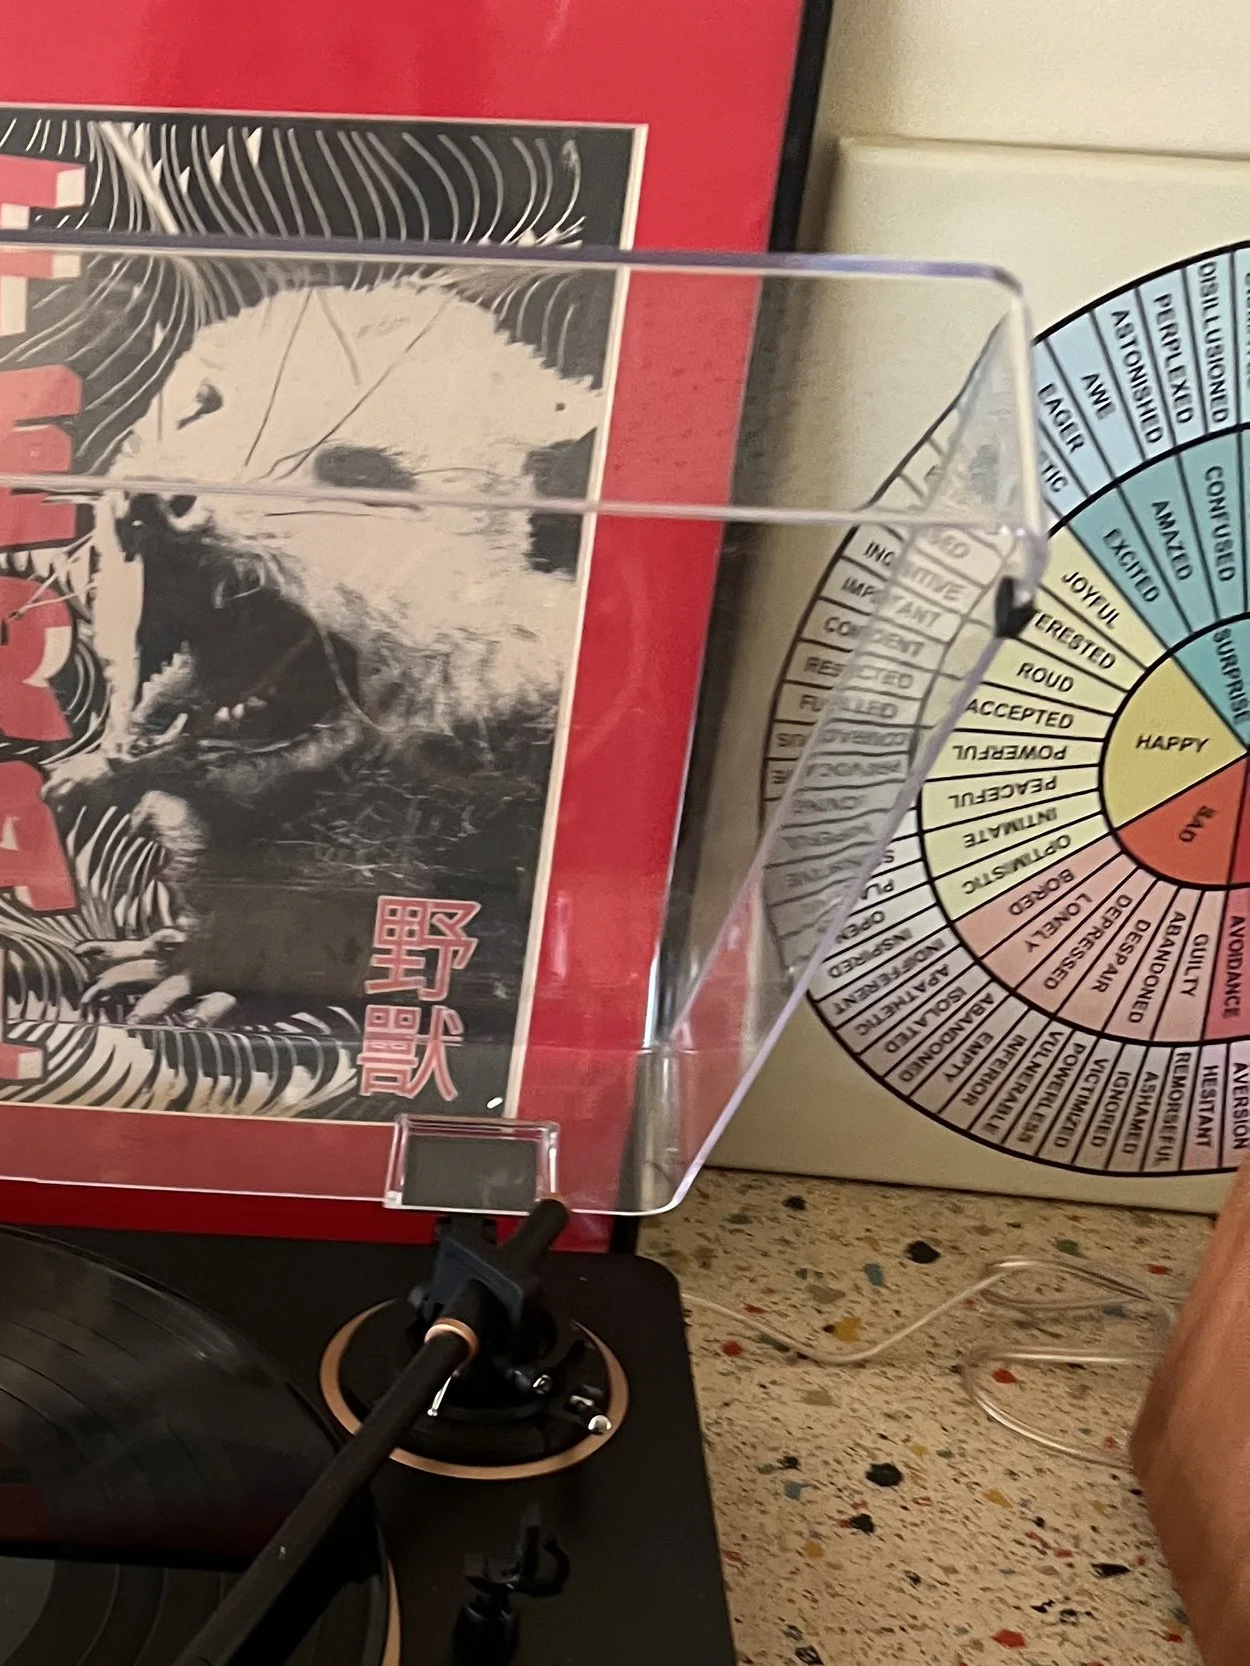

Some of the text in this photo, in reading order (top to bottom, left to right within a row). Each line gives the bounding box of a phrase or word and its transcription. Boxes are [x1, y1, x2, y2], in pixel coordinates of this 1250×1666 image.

[1111, 309, 1164, 444] ASTONISHED
[1153, 293, 1194, 424] PERPLEXED
[1198, 261, 1229, 424] DISILLUSIONED
[1038, 383, 1085, 455] EAGER
[1081, 373, 1116, 420] AWE
[1152, 500, 1193, 581] AMAZED
[1205, 465, 1236, 582] CONFUSED
[1061, 571, 1120, 630] JOYFUL
[1103, 527, 1160, 602] EXCITED
[1016, 662, 1074, 693] ROUD
[1034, 612, 1116, 669] ERESTED
[1213, 627, 1250, 725] SURPRISE
[965, 698, 1074, 729] ACCEPTED
[1135, 734, 1210, 753] HAPPY
[952, 744, 1068, 761] POWERFUL
[948, 775, 1058, 809] PEACEFUL
[962, 807, 1058, 849] INTIMATE
[1178, 804, 1218, 843] SAD
[961, 834, 1071, 895] OPTIMISTIC
[1008, 868, 1075, 916] BORED
[828, 928, 913, 979] INSPIRED
[1024, 893, 1093, 952] LONELY
[1043, 894, 1133, 990] DEPRESSED
[1091, 918, 1151, 993] DESPAIR
[356, 895, 482, 1102] 野獸
[832, 938, 945, 1016] INDIFFERENT
[854, 963, 950, 1036] APATHETIC
[1127, 911, 1187, 1023] ABANDONED
[1180, 933, 1209, 997] GUILTY
[1222, 915, 1246, 1019] AVOIDANCE
[884, 986, 967, 1054] ISOLATED
[898, 992, 995, 1083] ABANDONED
[943, 1031, 995, 1083] EMPTY
[960, 1033, 1028, 1106] INFERIOR
[982, 1031, 1065, 1136] VULNERABLE
[1016, 1042, 1087, 1144] POWERLESS
[1054, 1058, 1110, 1149] VICTIMIZED
[1196, 1064, 1219, 1149] HESITANT
[1232, 1062, 1250, 1150] AVERSION
[1090, 1070, 1131, 1148] IGNORED
[1122, 1070, 1159, 1155] ASHAMED
[1153, 1052, 1191, 1167] REMORSEFUL
